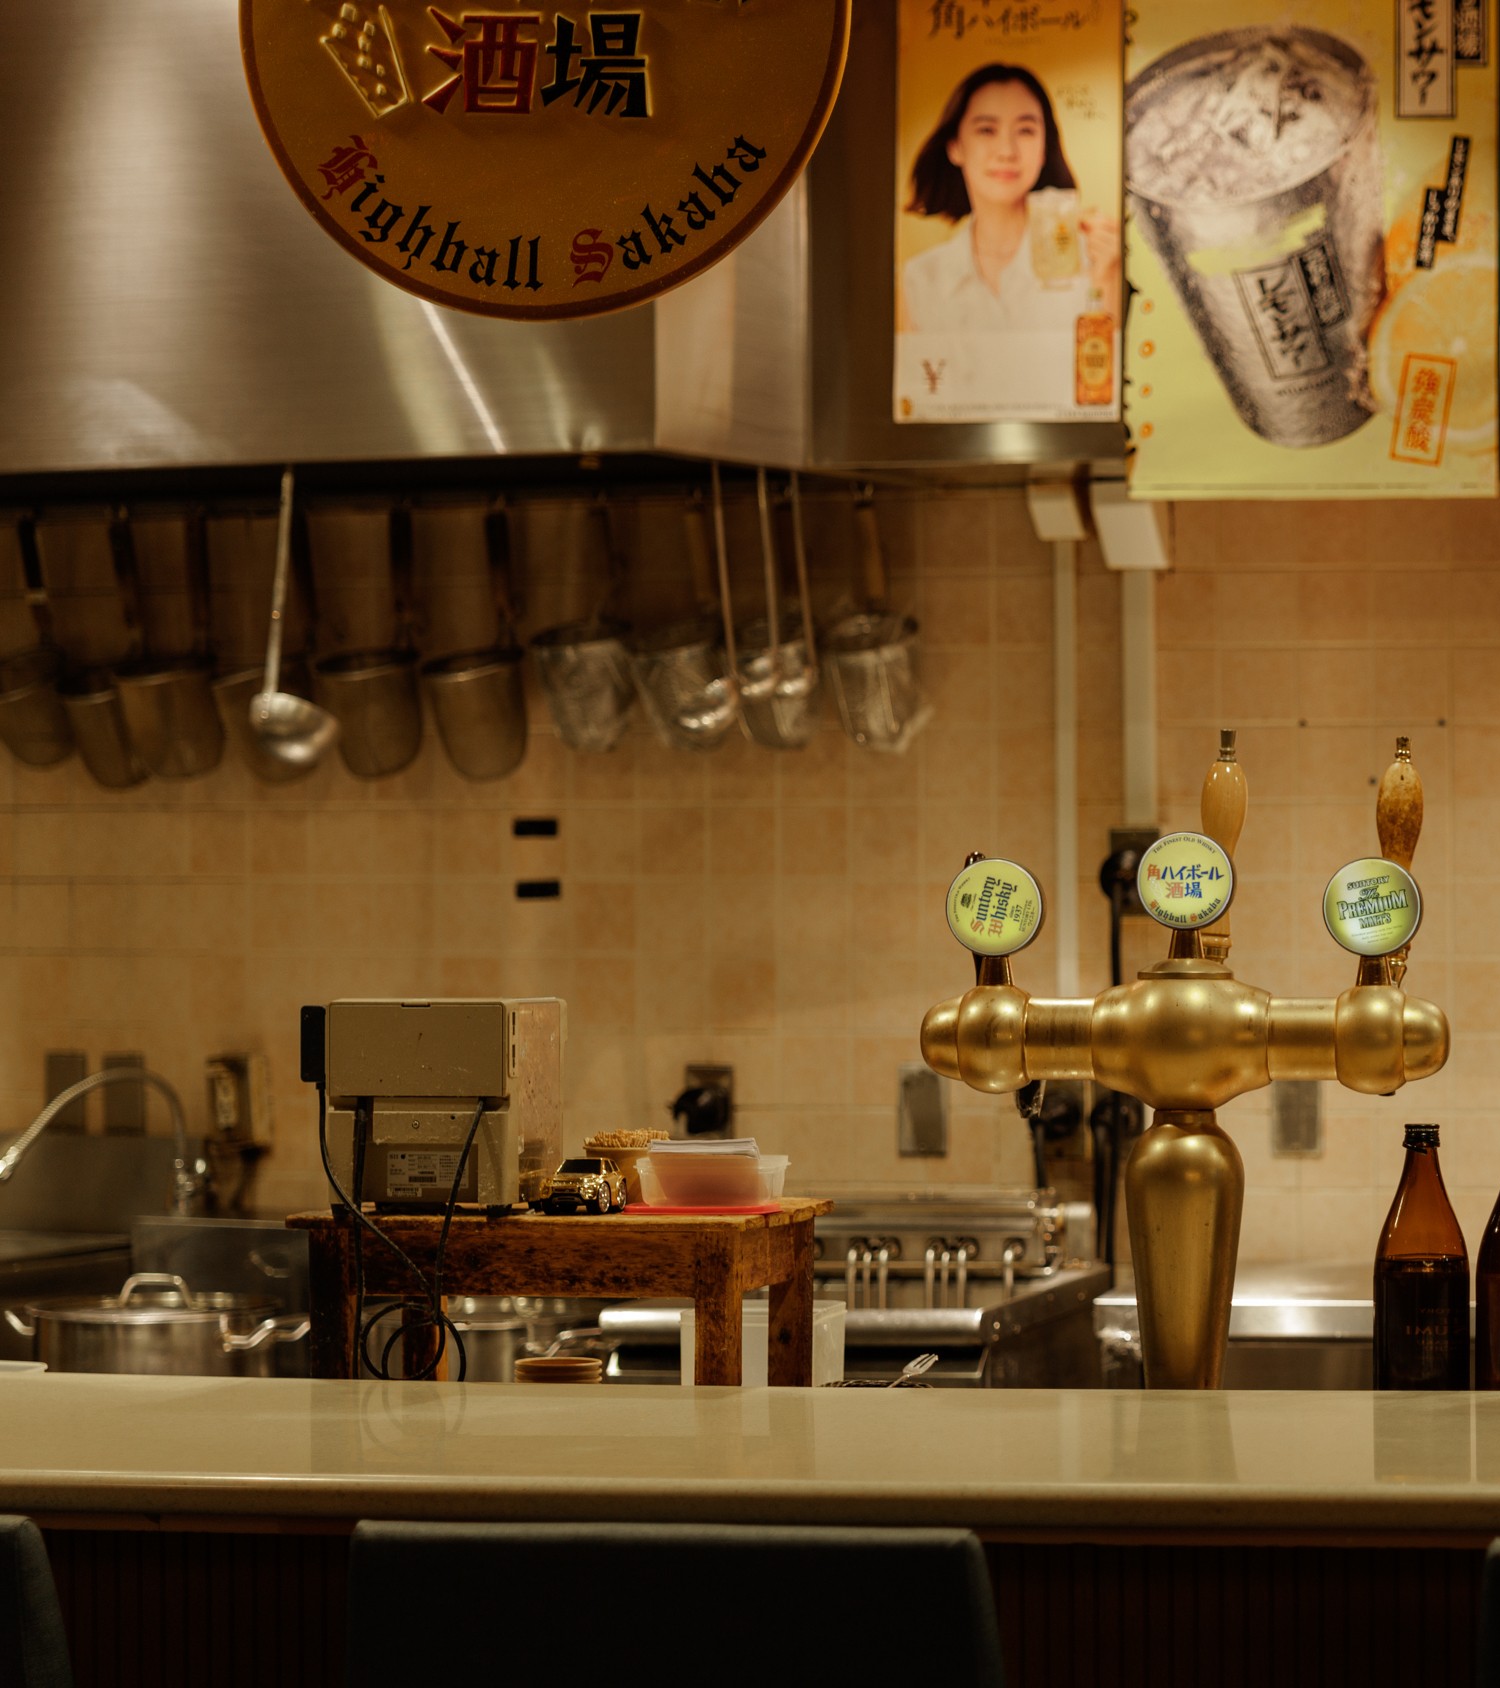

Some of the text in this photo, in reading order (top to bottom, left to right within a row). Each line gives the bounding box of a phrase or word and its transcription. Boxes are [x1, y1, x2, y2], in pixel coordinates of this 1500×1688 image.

[420, 6, 655, 118] 酒場
[317, 134, 768, 292] Highball Sakaba
[1147, 863, 1224, 881] 角ハイボール
[1346, 875, 1390, 890] SUNTORY
[970, 876, 1001, 936] Suntory
[1165, 881, 1203, 899] 酒場
[1336, 888, 1409, 921] PREMIUM
[987, 882, 1018, 938] Whisky
[1013, 904, 1023, 922] 1937
